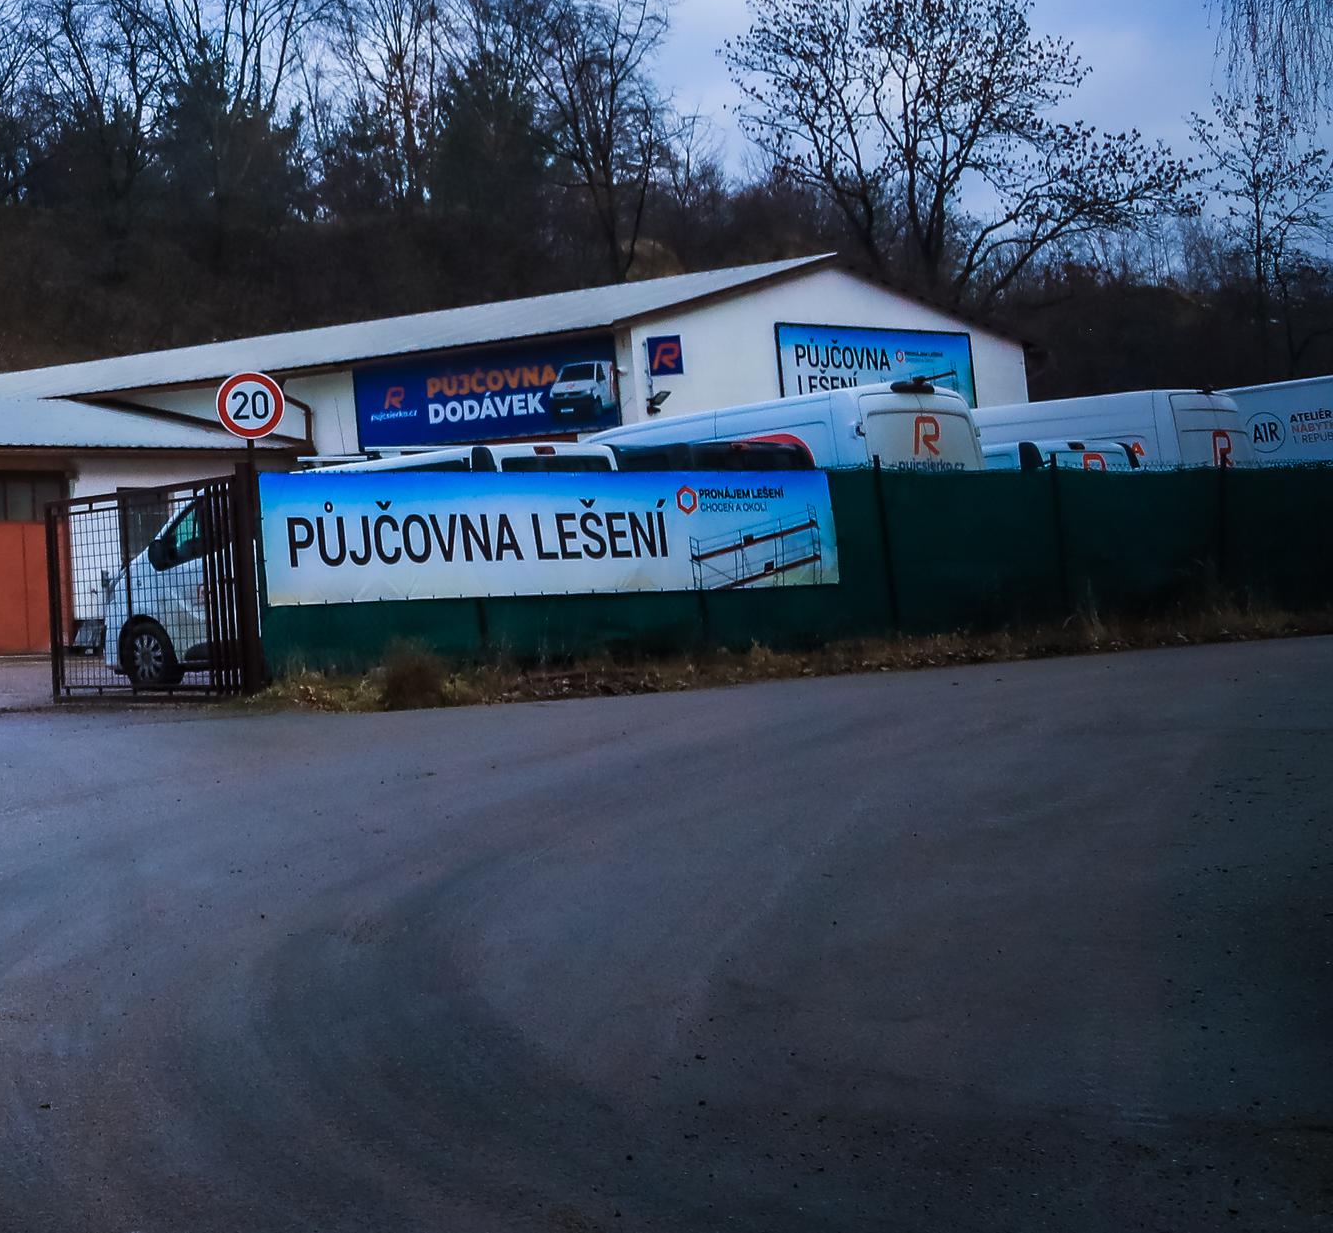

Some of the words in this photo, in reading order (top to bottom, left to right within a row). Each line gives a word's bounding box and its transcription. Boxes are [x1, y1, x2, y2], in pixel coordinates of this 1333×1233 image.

[794, 337, 891, 371] PŮJČOVNA
[233, 390, 270, 420] 20
[428, 391, 546, 424] DODÁVEK
[699, 486, 750, 499] PRONÁJEM
[752, 486, 784, 498] LEŠENÍ
[286, 500, 524, 567] PŮJČOVNA
[533, 498, 669, 560] LEŠENÍ
